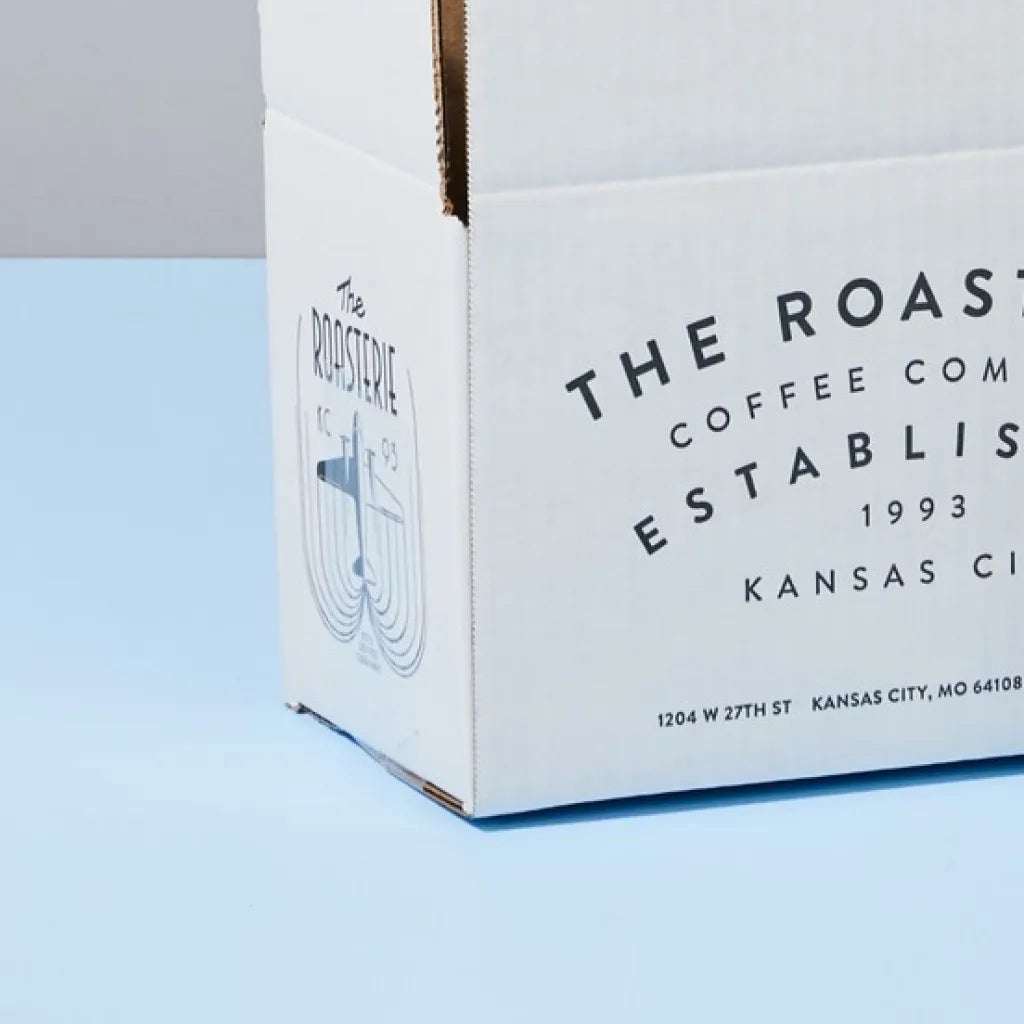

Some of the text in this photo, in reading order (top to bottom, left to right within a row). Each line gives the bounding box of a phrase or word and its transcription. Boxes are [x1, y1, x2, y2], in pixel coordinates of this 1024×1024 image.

[337, 275, 366, 318] The
[311, 305, 398, 416] ROASTERIE
[565, 316, 725, 420] THE
[670, 367, 864, 449] COFFEE
[862, 494, 966, 528] 1993
[744, 559, 935, 602] KANSAS
[657, 710, 696, 728] 1204
[703, 707, 719, 723] W
[724, 703, 767, 721] 27TH
[773, 700, 791, 715] ST
[812, 690, 882, 711] KANSAS
[888, 685, 932, 703] CITY,
[938, 682, 967, 698] MO
[974, 675, 1022, 694] 64108
